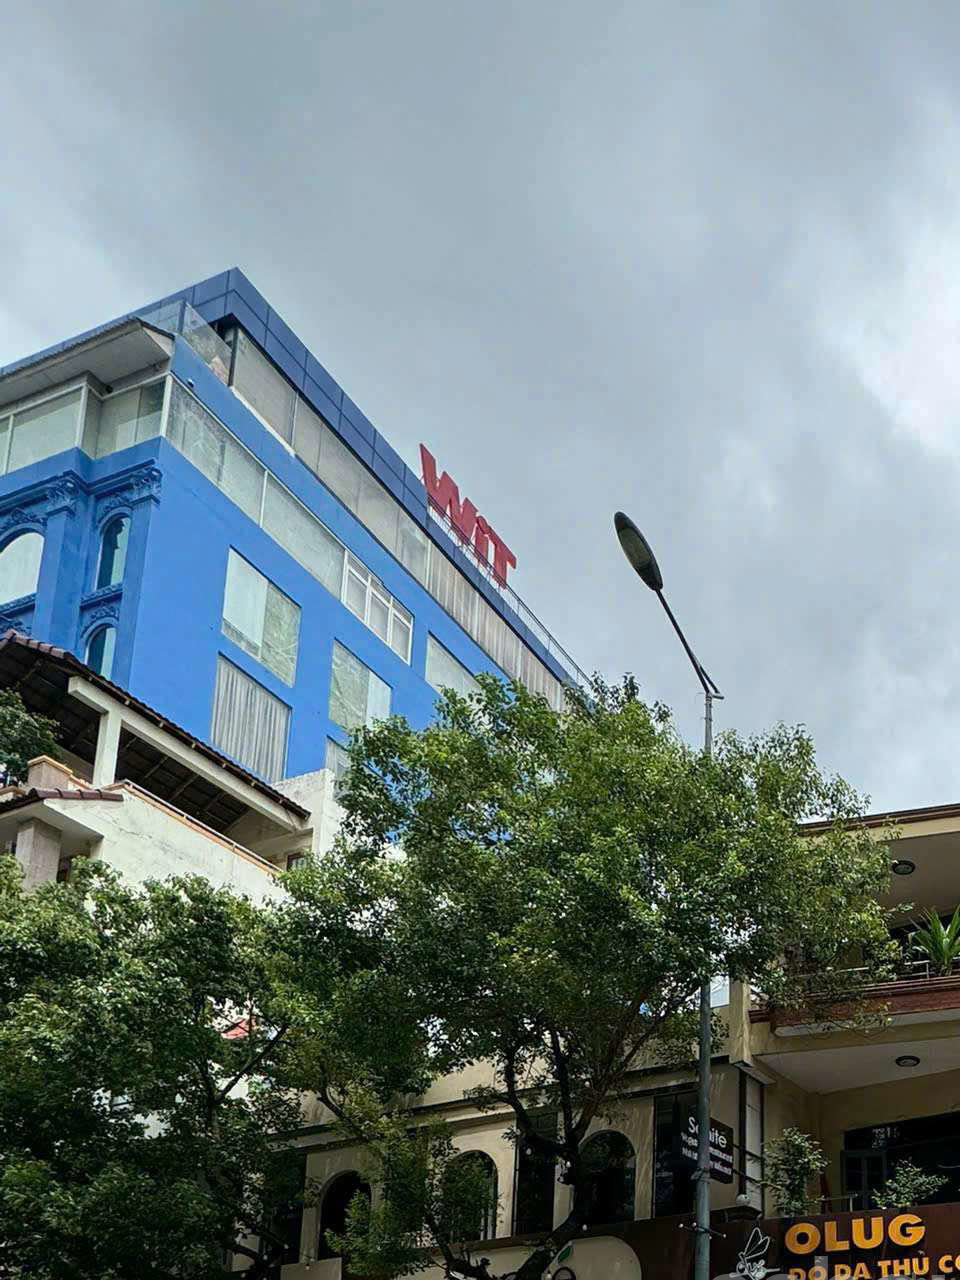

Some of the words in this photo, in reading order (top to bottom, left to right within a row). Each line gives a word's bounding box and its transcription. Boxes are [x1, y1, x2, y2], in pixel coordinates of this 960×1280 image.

[785, 1213, 926, 1255] OLUG
[834, 1262, 872, 1280] DA
[878, 1250, 930, 1277] THỦ
